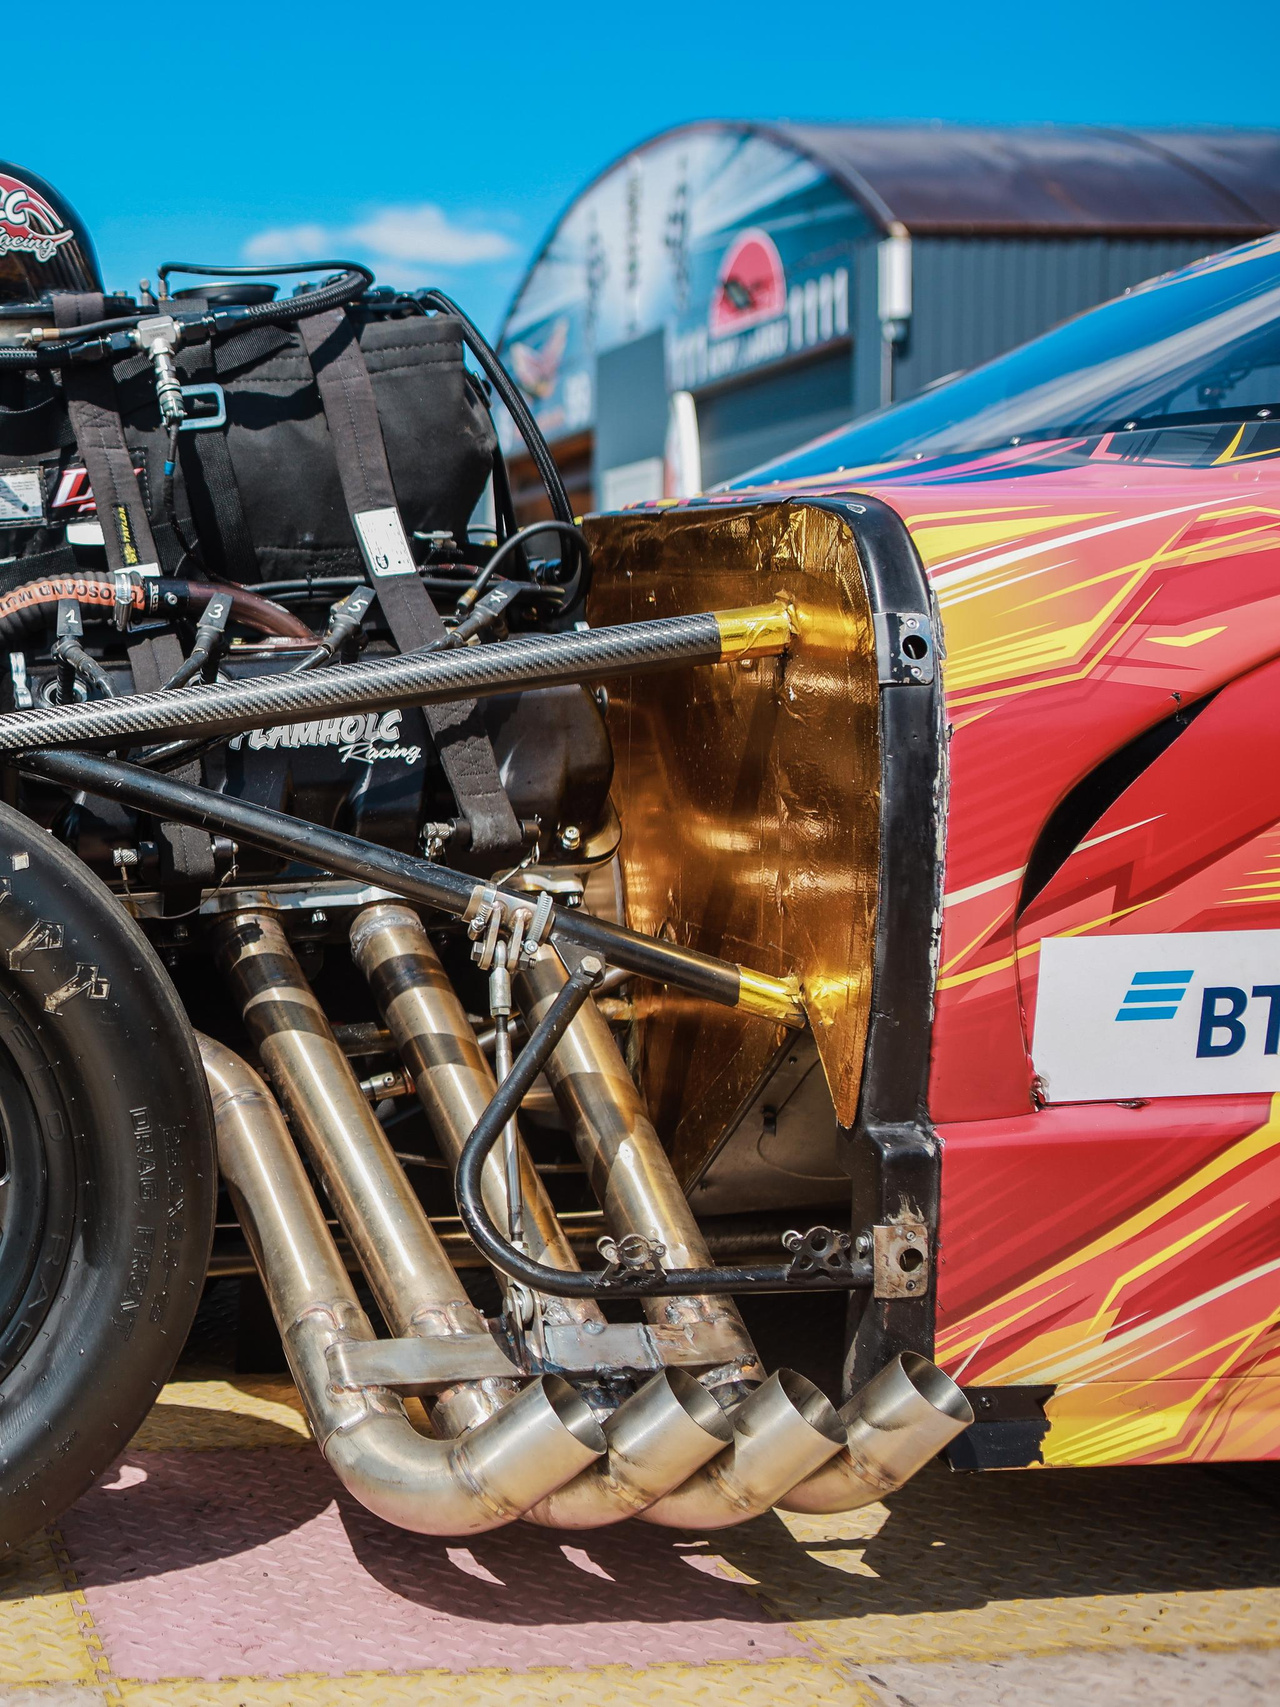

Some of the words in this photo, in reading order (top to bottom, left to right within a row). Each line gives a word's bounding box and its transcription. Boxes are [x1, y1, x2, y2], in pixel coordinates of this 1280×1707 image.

[118, 506, 131, 543] TAYLOR
[65, 609, 79, 624] 1
[207, 603, 224, 619] 3
[347, 598, 369, 613] 5
[338, 742, 422, 766] Racing
[128, 1105, 157, 1201] DRAG
[107, 1225, 159, 1342] FRONT
